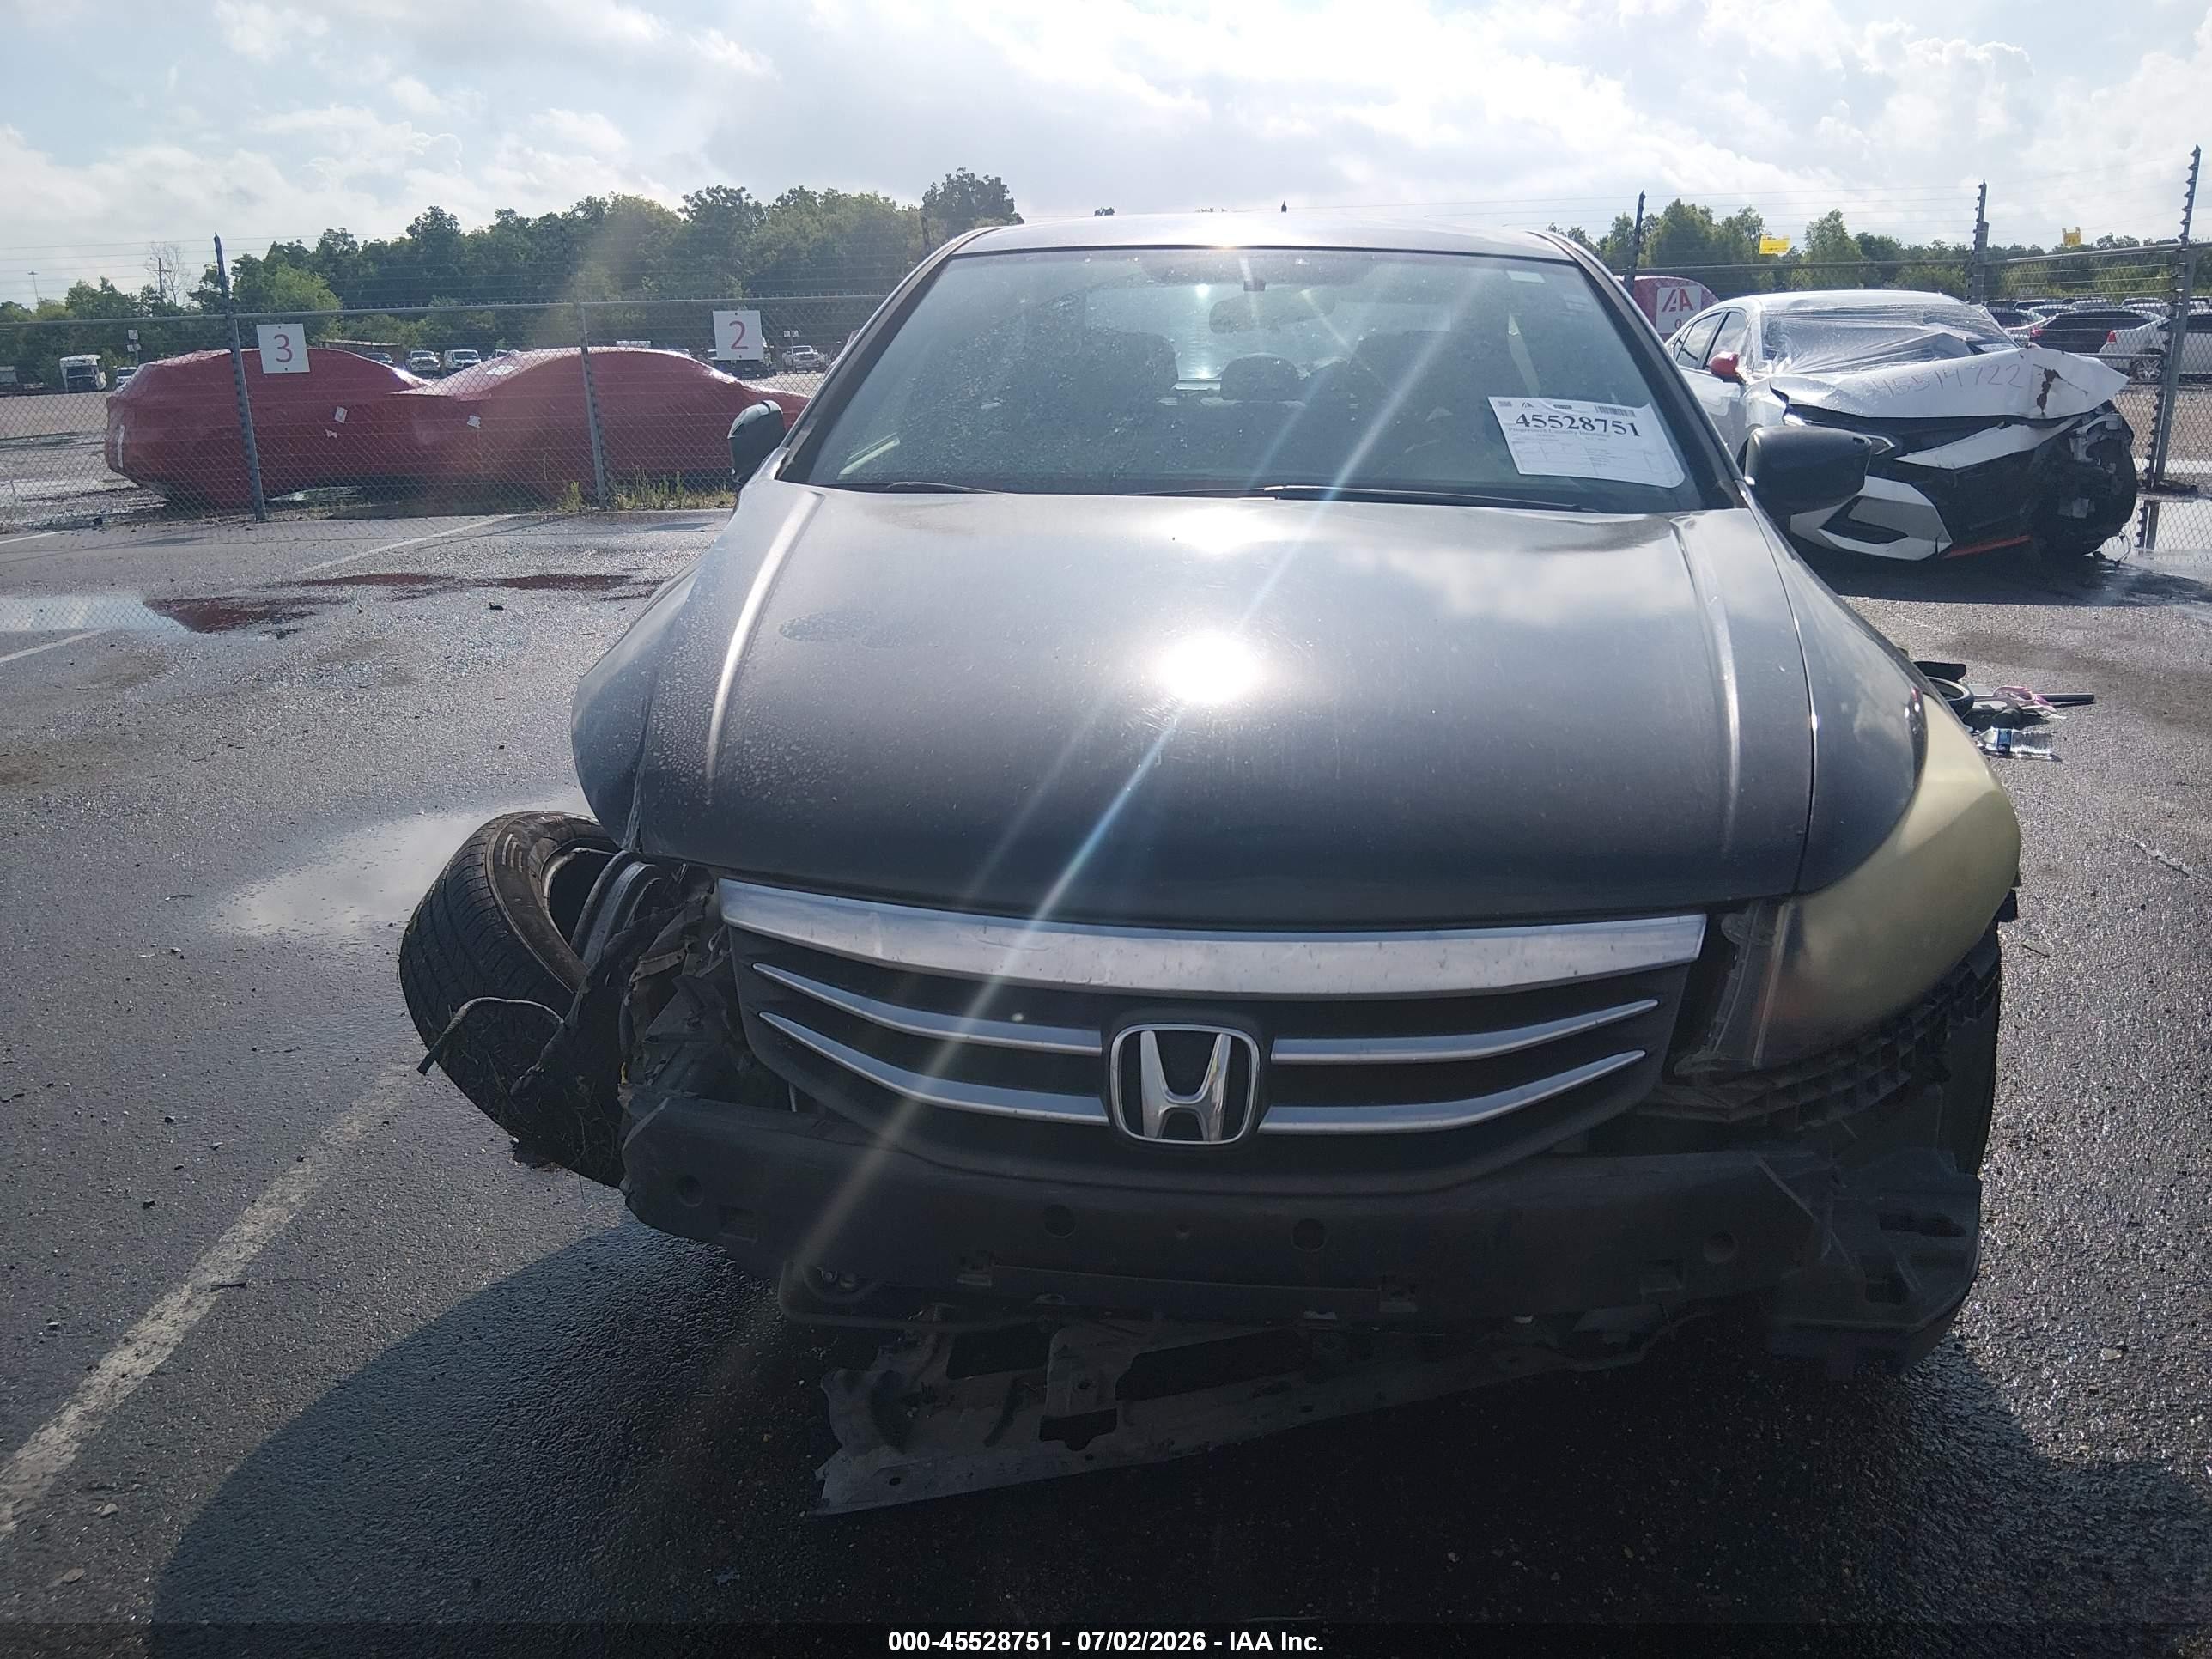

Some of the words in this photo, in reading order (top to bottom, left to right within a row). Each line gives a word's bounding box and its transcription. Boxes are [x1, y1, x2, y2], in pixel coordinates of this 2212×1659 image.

[274, 333, 293, 363] 3
[729, 320, 749, 350] 2
[1516, 413, 1641, 437] 45528751
